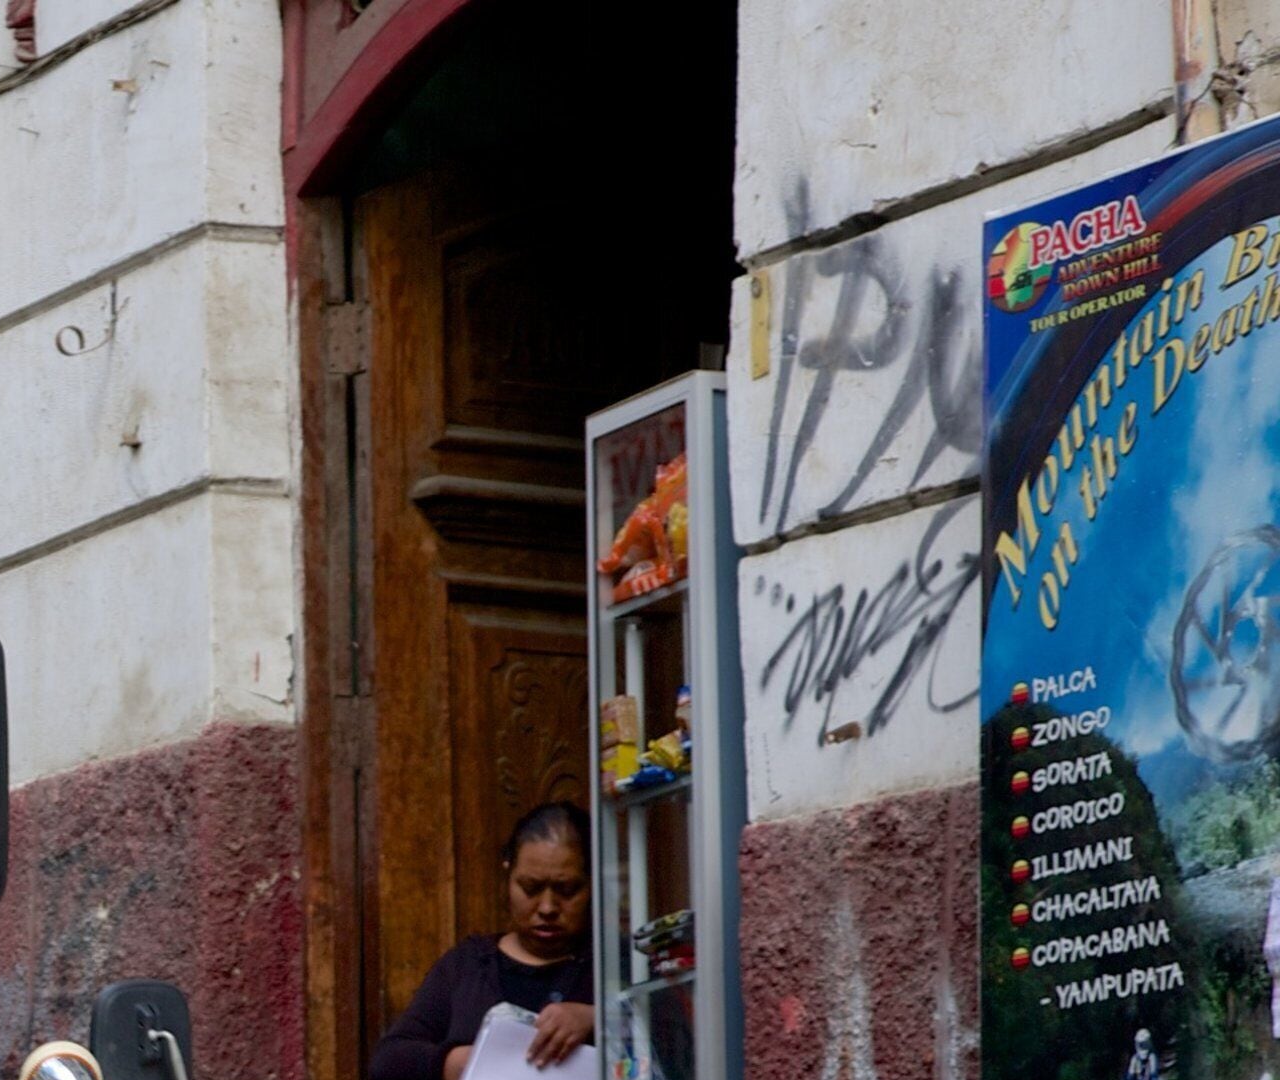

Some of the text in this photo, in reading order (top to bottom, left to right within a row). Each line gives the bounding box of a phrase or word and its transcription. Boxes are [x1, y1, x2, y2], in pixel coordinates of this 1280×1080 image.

[1028, 194, 1146, 271] PACHA
[1058, 231, 1164, 283] ADVENTURE
[1062, 253, 1163, 303] DOWN HILL
[1029, 284, 1147, 333] TOUR OPERATOR
[995, 269, 1205, 606] Mountain
[1037, 520, 1080, 632] on
[1080, 401, 1138, 522] the
[1030, 666, 1097, 704] PALCA
[1030, 705, 1112, 748] ZONGO
[1030, 751, 1113, 794] SORATA
[1030, 792, 1126, 835] COROICO
[1030, 835, 1134, 882] ILLIMANI
[1031, 875, 1162, 923] CHACALTAYA
[1031, 918, 1171, 967] COPACABANA
[1055, 962, 1185, 1010] YAMPUPATA
